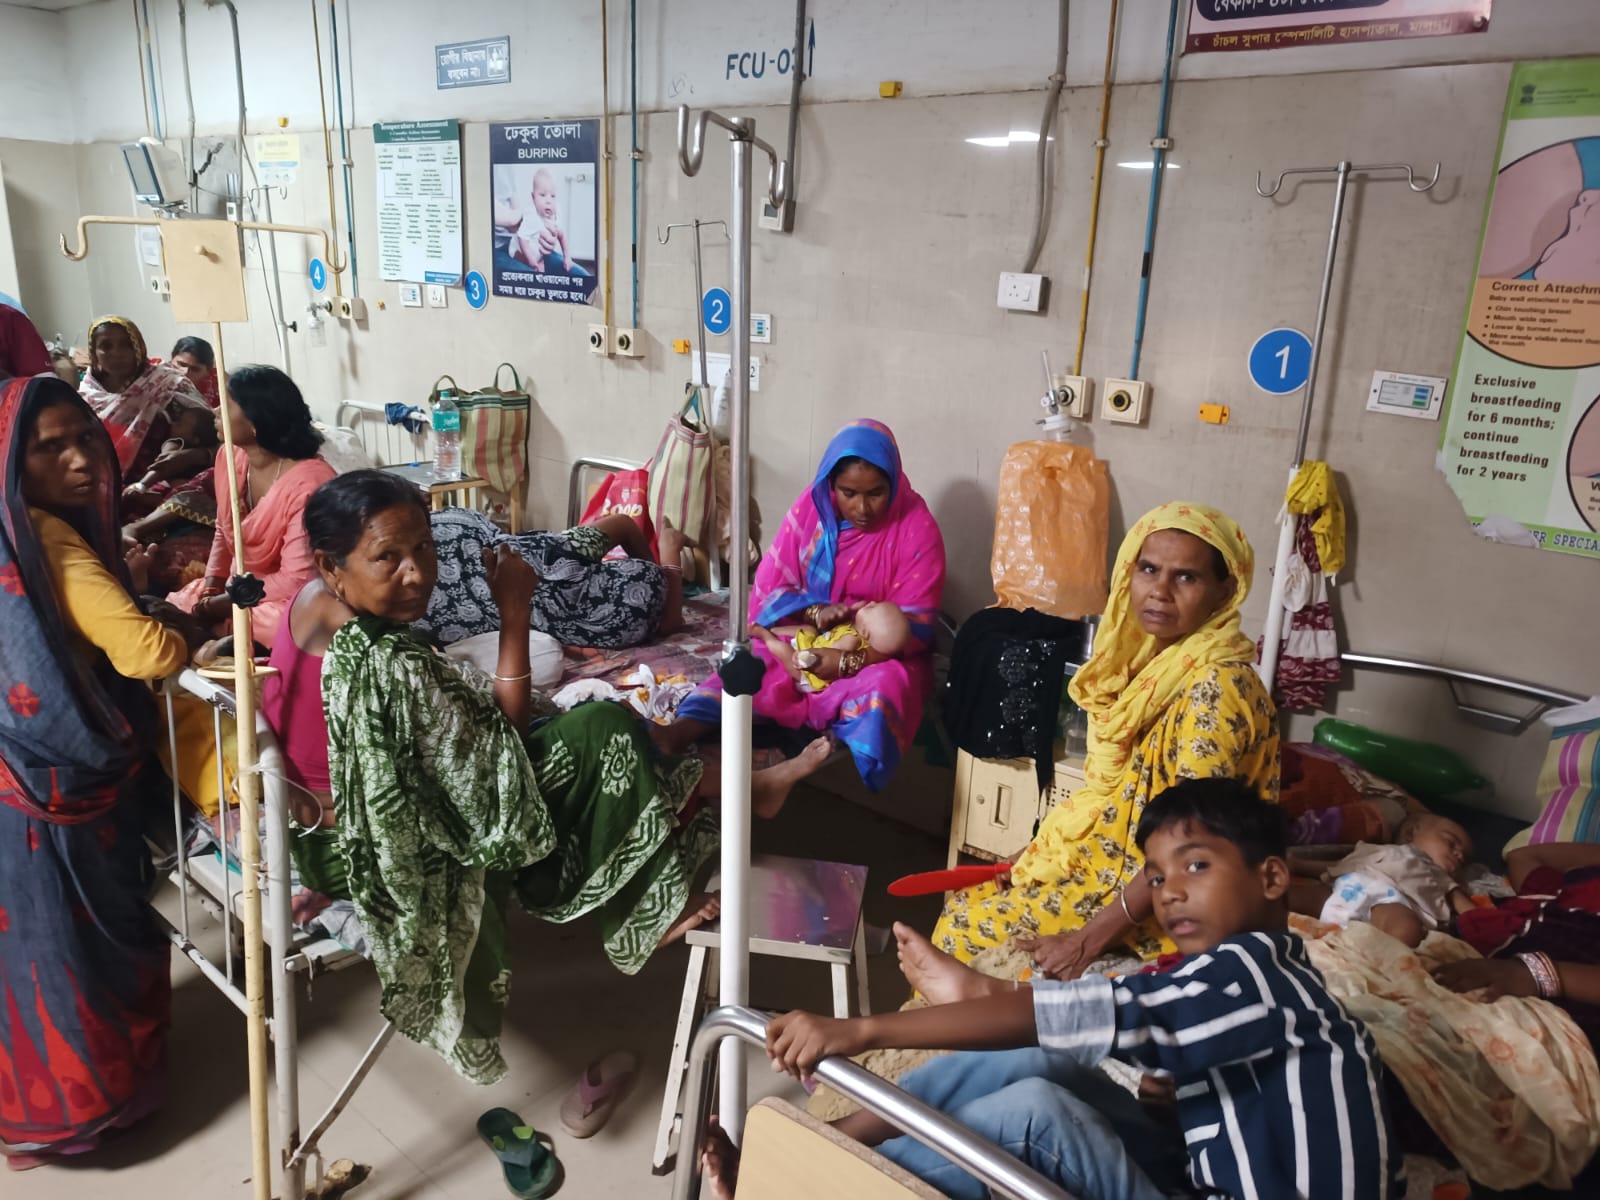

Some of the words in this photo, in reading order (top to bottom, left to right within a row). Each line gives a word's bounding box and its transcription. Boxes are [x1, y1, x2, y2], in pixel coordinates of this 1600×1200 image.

[1242, 33, 1270, 47] সুপার
[1275, 25, 1335, 43] স্পেশালিটি
[726, 48, 797, 80] FCU-0
[504, 126, 539, 144] ঢেকুর
[542, 122, 581, 139] তোলা
[518, 147, 568, 159] BURPING
[314, 266, 322, 283] 4
[471, 280, 480, 300] 3
[1491, 281, 1539, 292] Correct
[711, 299, 723, 324] 2
[1275, 345, 1290, 379] 1
[1474, 374, 1537, 389] Exclusive
[1470, 392, 1562, 413] breastfeeding
[1467, 410, 1486, 422] for
[1490, 412, 1498, 423] 6
[1502, 415, 1555, 430] months;
[1463, 430, 1519, 444] continue
[1459, 446, 1549, 468] breastfeeding
[1456, 464, 1475, 476] for
[1479, 466, 1487, 478] 2
[1492, 469, 1527, 482] years
[1554, 533, 1600, 552] SPECIA
